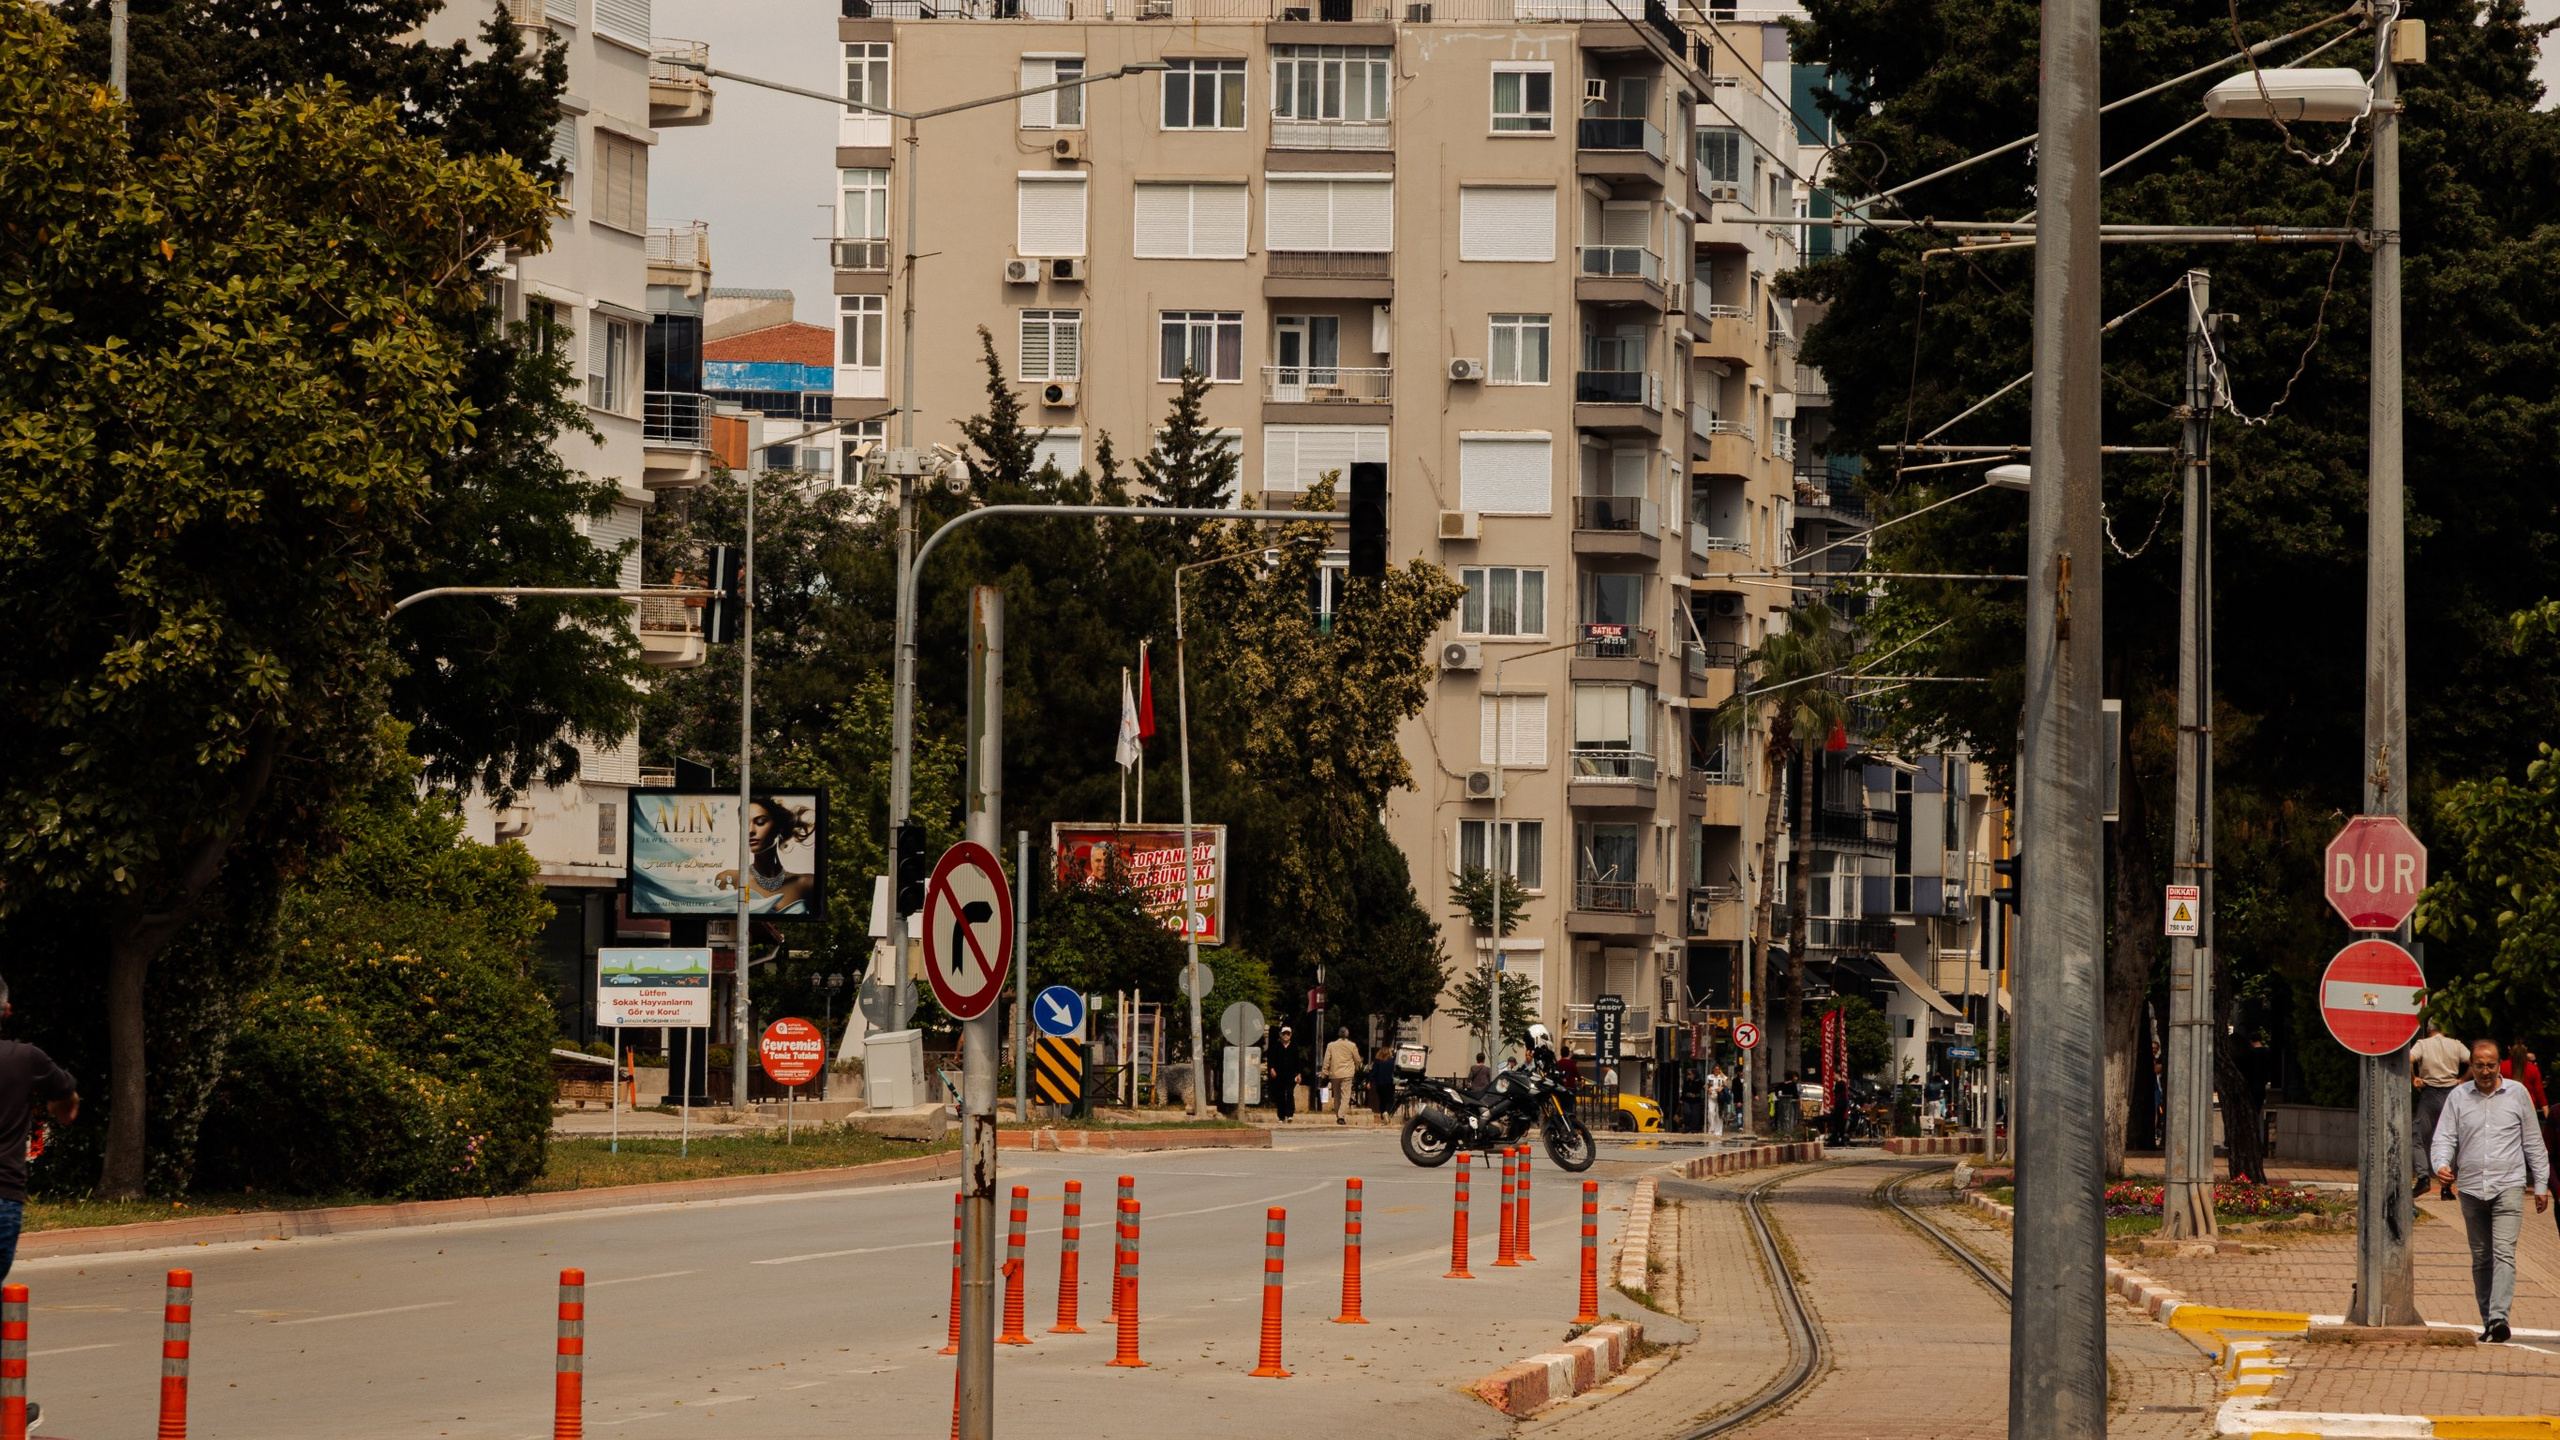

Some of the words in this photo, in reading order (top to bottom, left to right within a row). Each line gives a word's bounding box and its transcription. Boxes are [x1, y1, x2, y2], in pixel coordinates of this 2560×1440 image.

[1592, 626, 1622, 635] SATILIK
[1192, 842, 1212, 861] GİY
[641, 856, 673, 870] Heart
[674, 861, 682, 871] of
[684, 857, 725, 869] Diamond
[1128, 860, 1212, 888] TRİBÜNDKİ
[2334, 852, 2417, 895] DUR
[639, 989, 667, 997] Lütfen
[640, 999, 694, 1008] Hayvanlarını
[627, 1008, 643, 1016] Gör
[657, 1008, 680, 1016] Koru!
[1603, 1013, 1615, 1058] HOTEL
[762, 1038, 822, 1054] Çevremizi
[769, 1051, 792, 1060] Temiz
[793, 1051, 819, 1060] Tutalım
